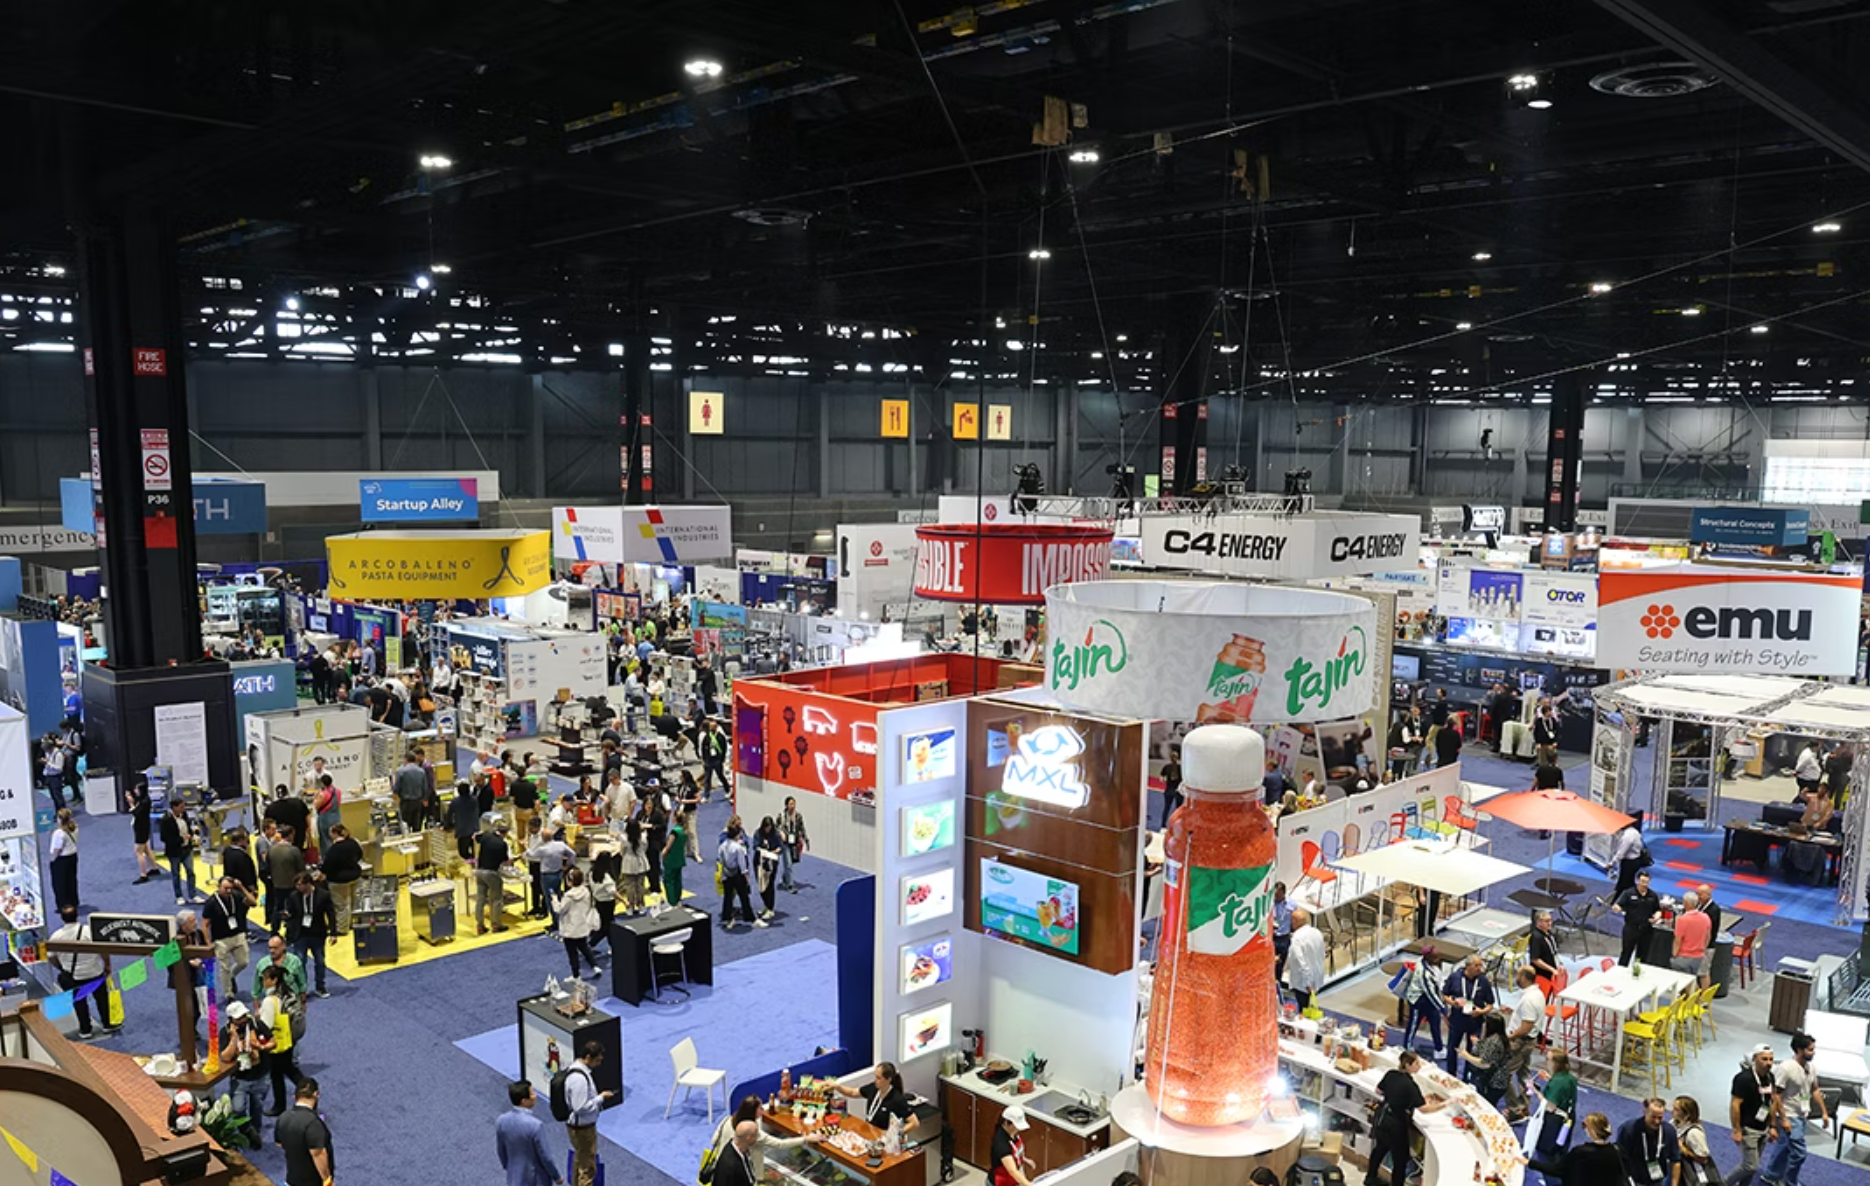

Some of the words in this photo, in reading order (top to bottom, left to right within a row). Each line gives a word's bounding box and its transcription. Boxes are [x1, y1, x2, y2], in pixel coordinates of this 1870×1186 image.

[138, 351, 160, 361] FIRE
[138, 363, 163, 372] HOSE
[148, 495, 169, 505] P36
[376, 498, 429, 512] Startup
[430, 497, 464, 512] Alley
[656, 525, 718, 534] INTERNATIONAL
[1700, 517, 1738, 529] Structural
[1739, 518, 1776, 530] Concepts
[672, 533, 719, 542] INDUSTRIES
[1164, 529, 1216, 555] C4
[1218, 533, 1287, 561] ENERGY
[1330, 536, 1366, 562] C4
[1366, 533, 1407, 559] ENERGY
[348, 558, 473, 570] ARCOBALENO
[361, 571, 394, 581] PASTA
[397, 571, 458, 581] EQUIPMENT
[1684, 605, 1813, 641] emu
[1637, 646, 1710, 668] Seating
[1714, 647, 1753, 665] with
[1007, 760, 1078, 795] MXL
